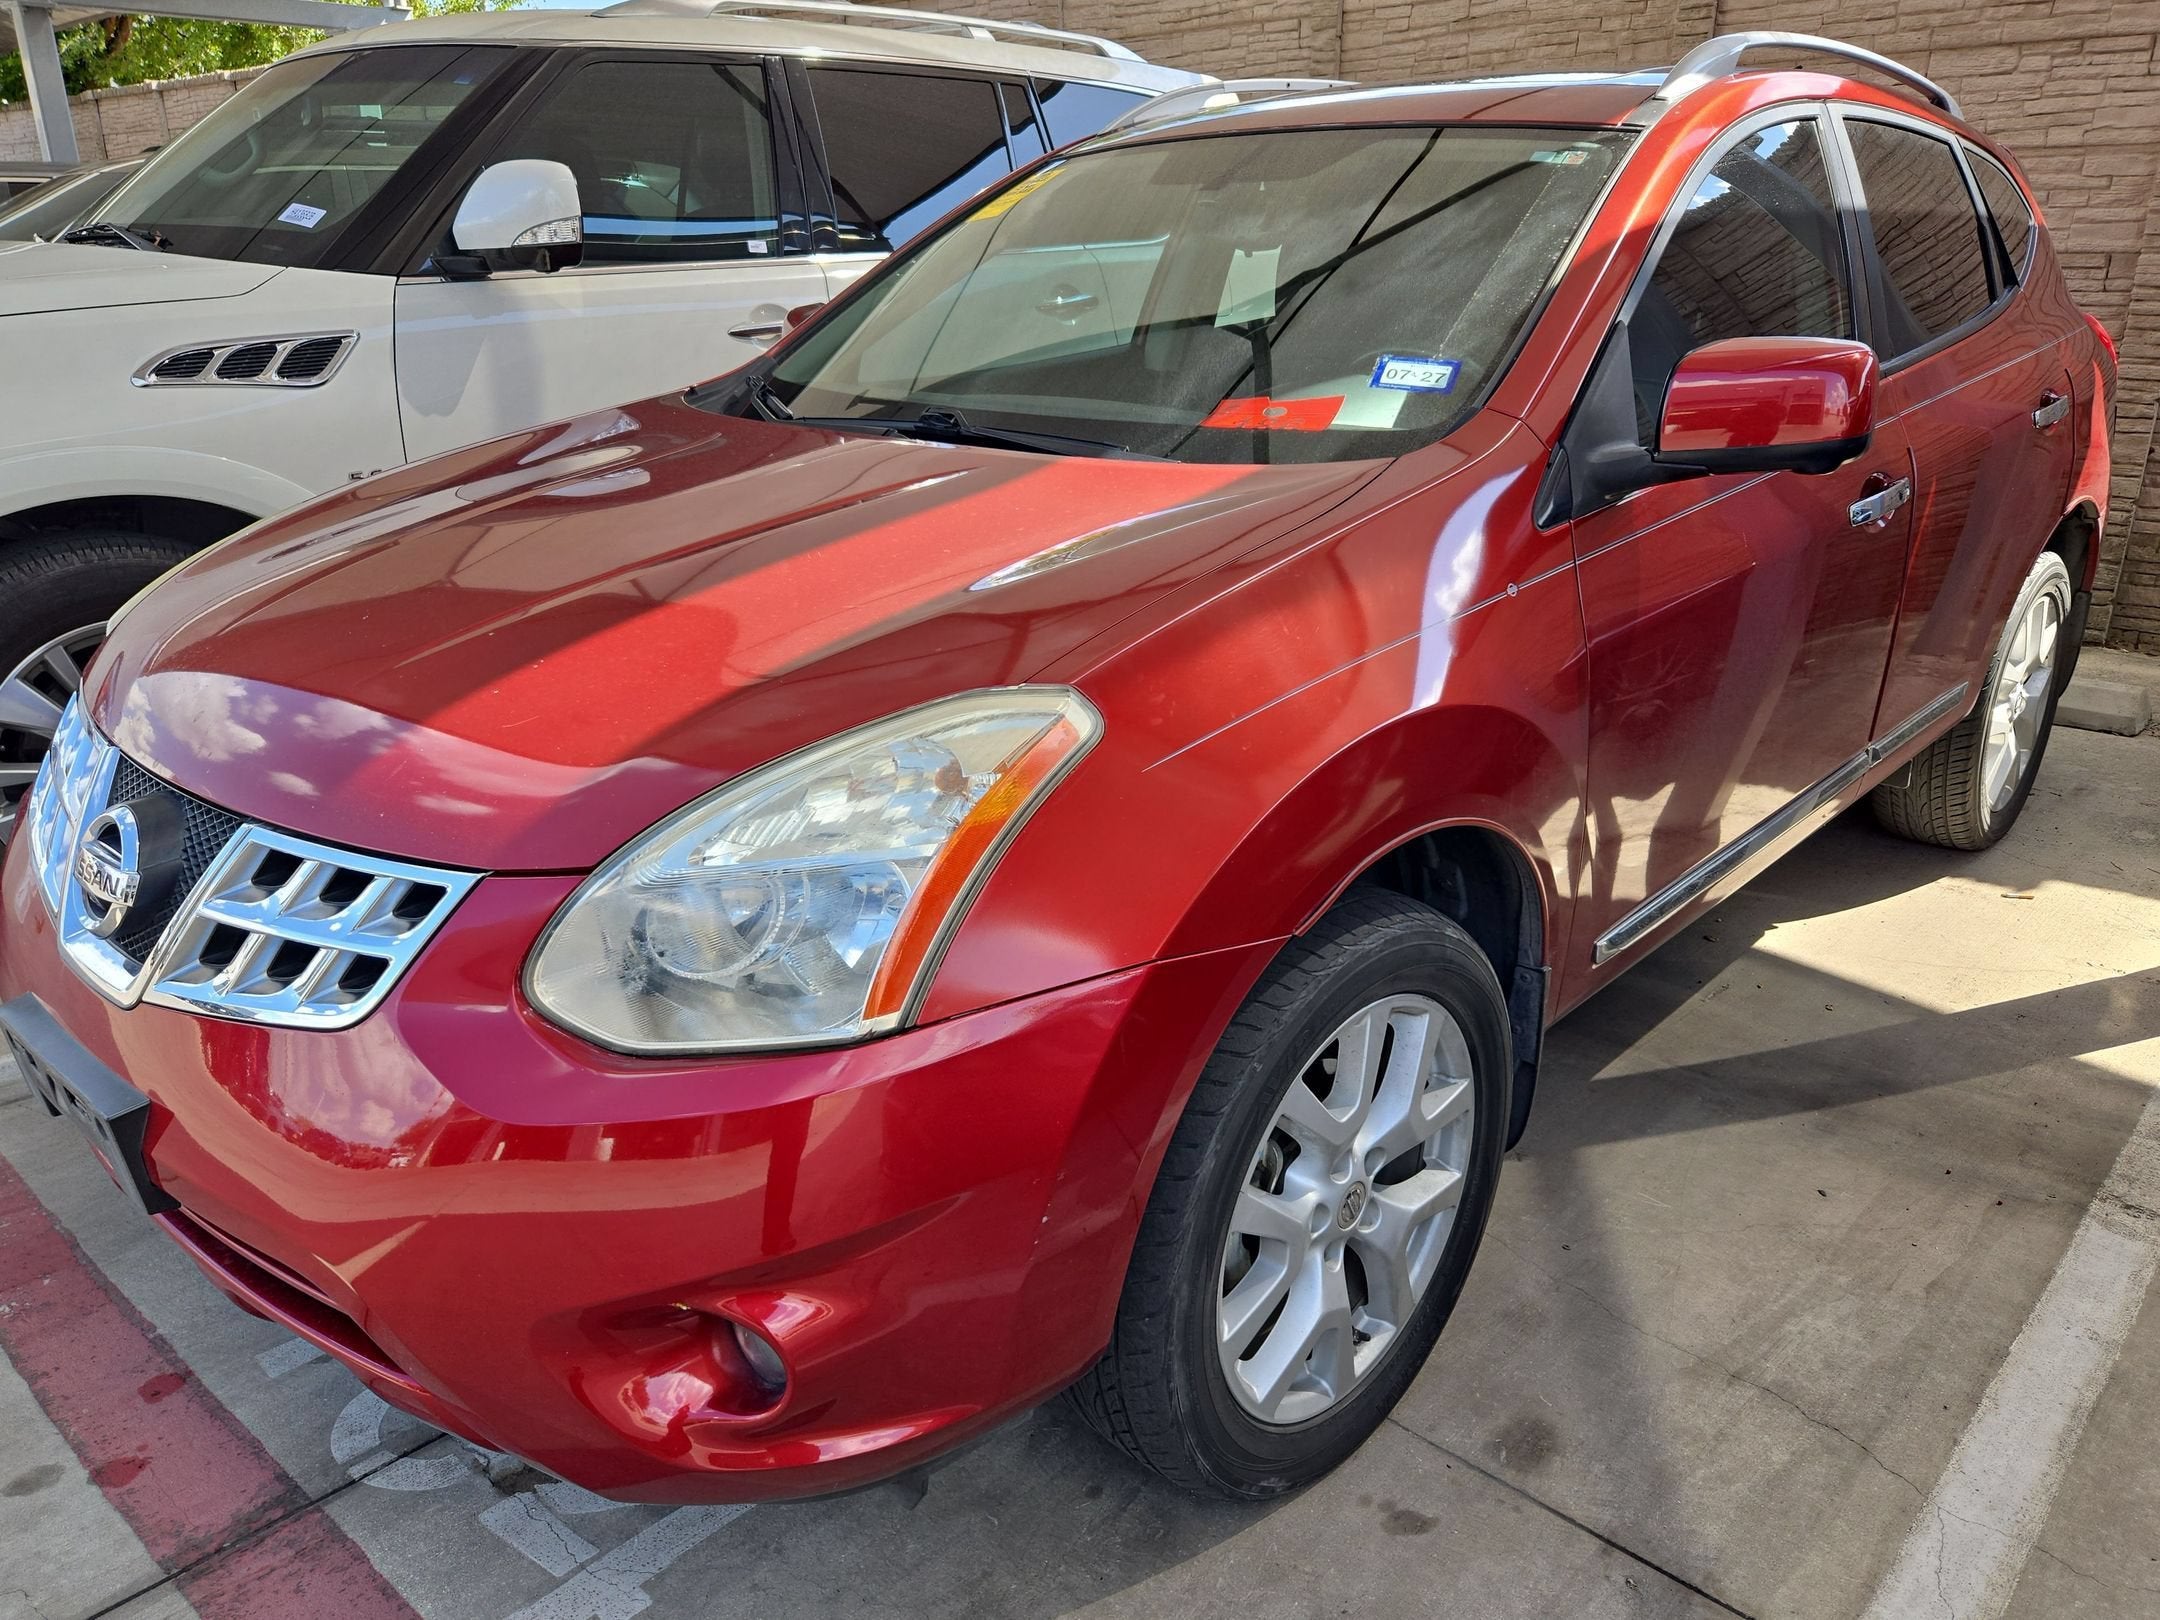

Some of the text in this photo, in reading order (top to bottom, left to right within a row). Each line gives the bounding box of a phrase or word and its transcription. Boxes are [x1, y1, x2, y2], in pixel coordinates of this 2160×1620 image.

[1386, 368, 1447, 383] 07 27
[77, 857, 121, 897] SSAN
